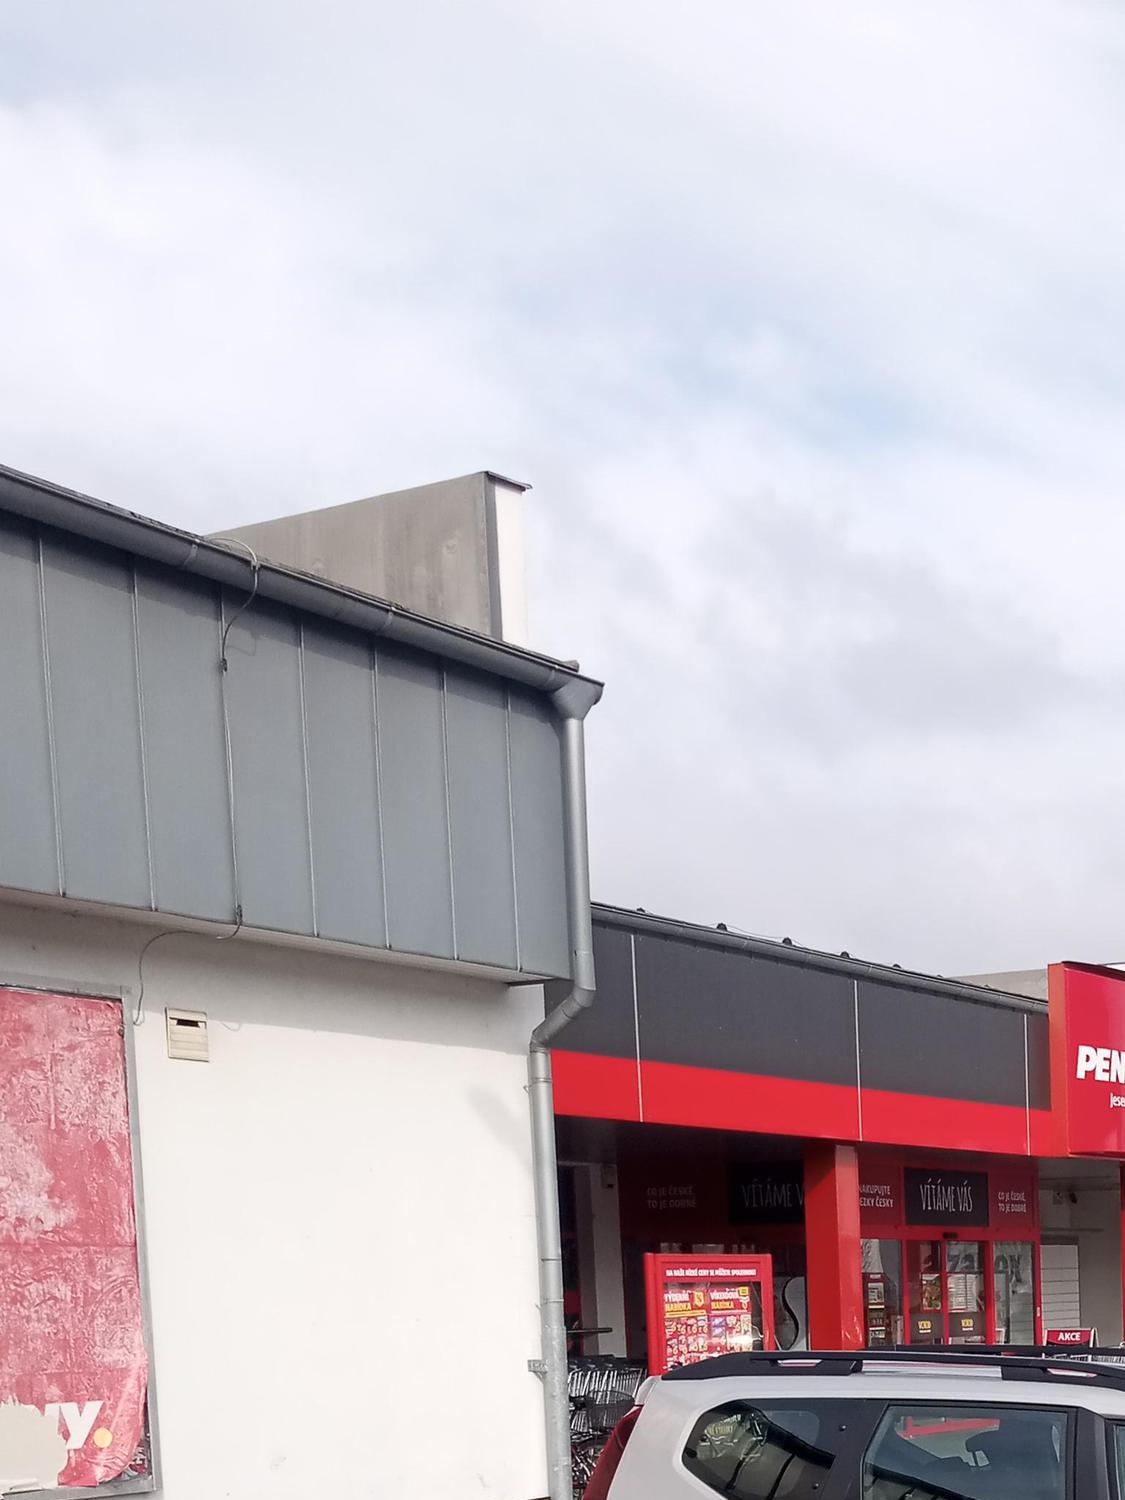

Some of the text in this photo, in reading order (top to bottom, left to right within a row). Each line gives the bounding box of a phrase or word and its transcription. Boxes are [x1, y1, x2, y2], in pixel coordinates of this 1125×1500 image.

[919, 1178, 973, 1213] VÍTÁME VÁS
[859, 1197, 875, 1208] EZKY
[1057, 1332, 1081, 1342] AKCE
